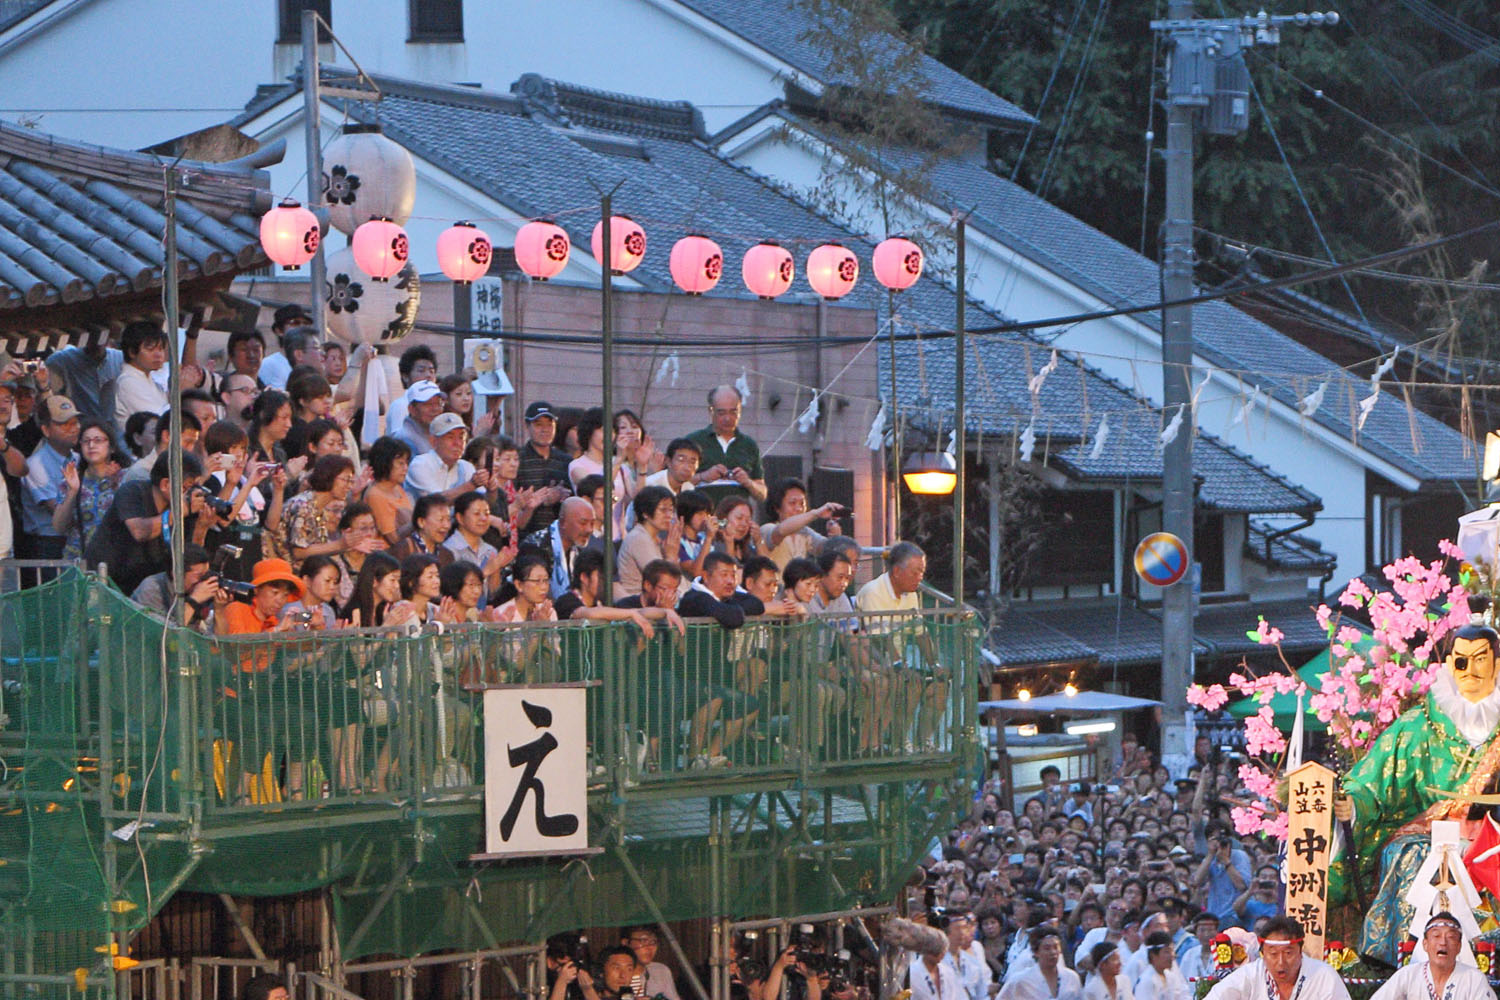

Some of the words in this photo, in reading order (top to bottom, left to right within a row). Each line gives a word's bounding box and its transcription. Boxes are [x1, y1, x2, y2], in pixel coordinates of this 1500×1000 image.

[499, 699, 579, 843] え
[1293, 781, 1312, 815] 山笠
[1311, 780, 1328, 814] 六番
[1288, 827, 1328, 937] 中洲流
